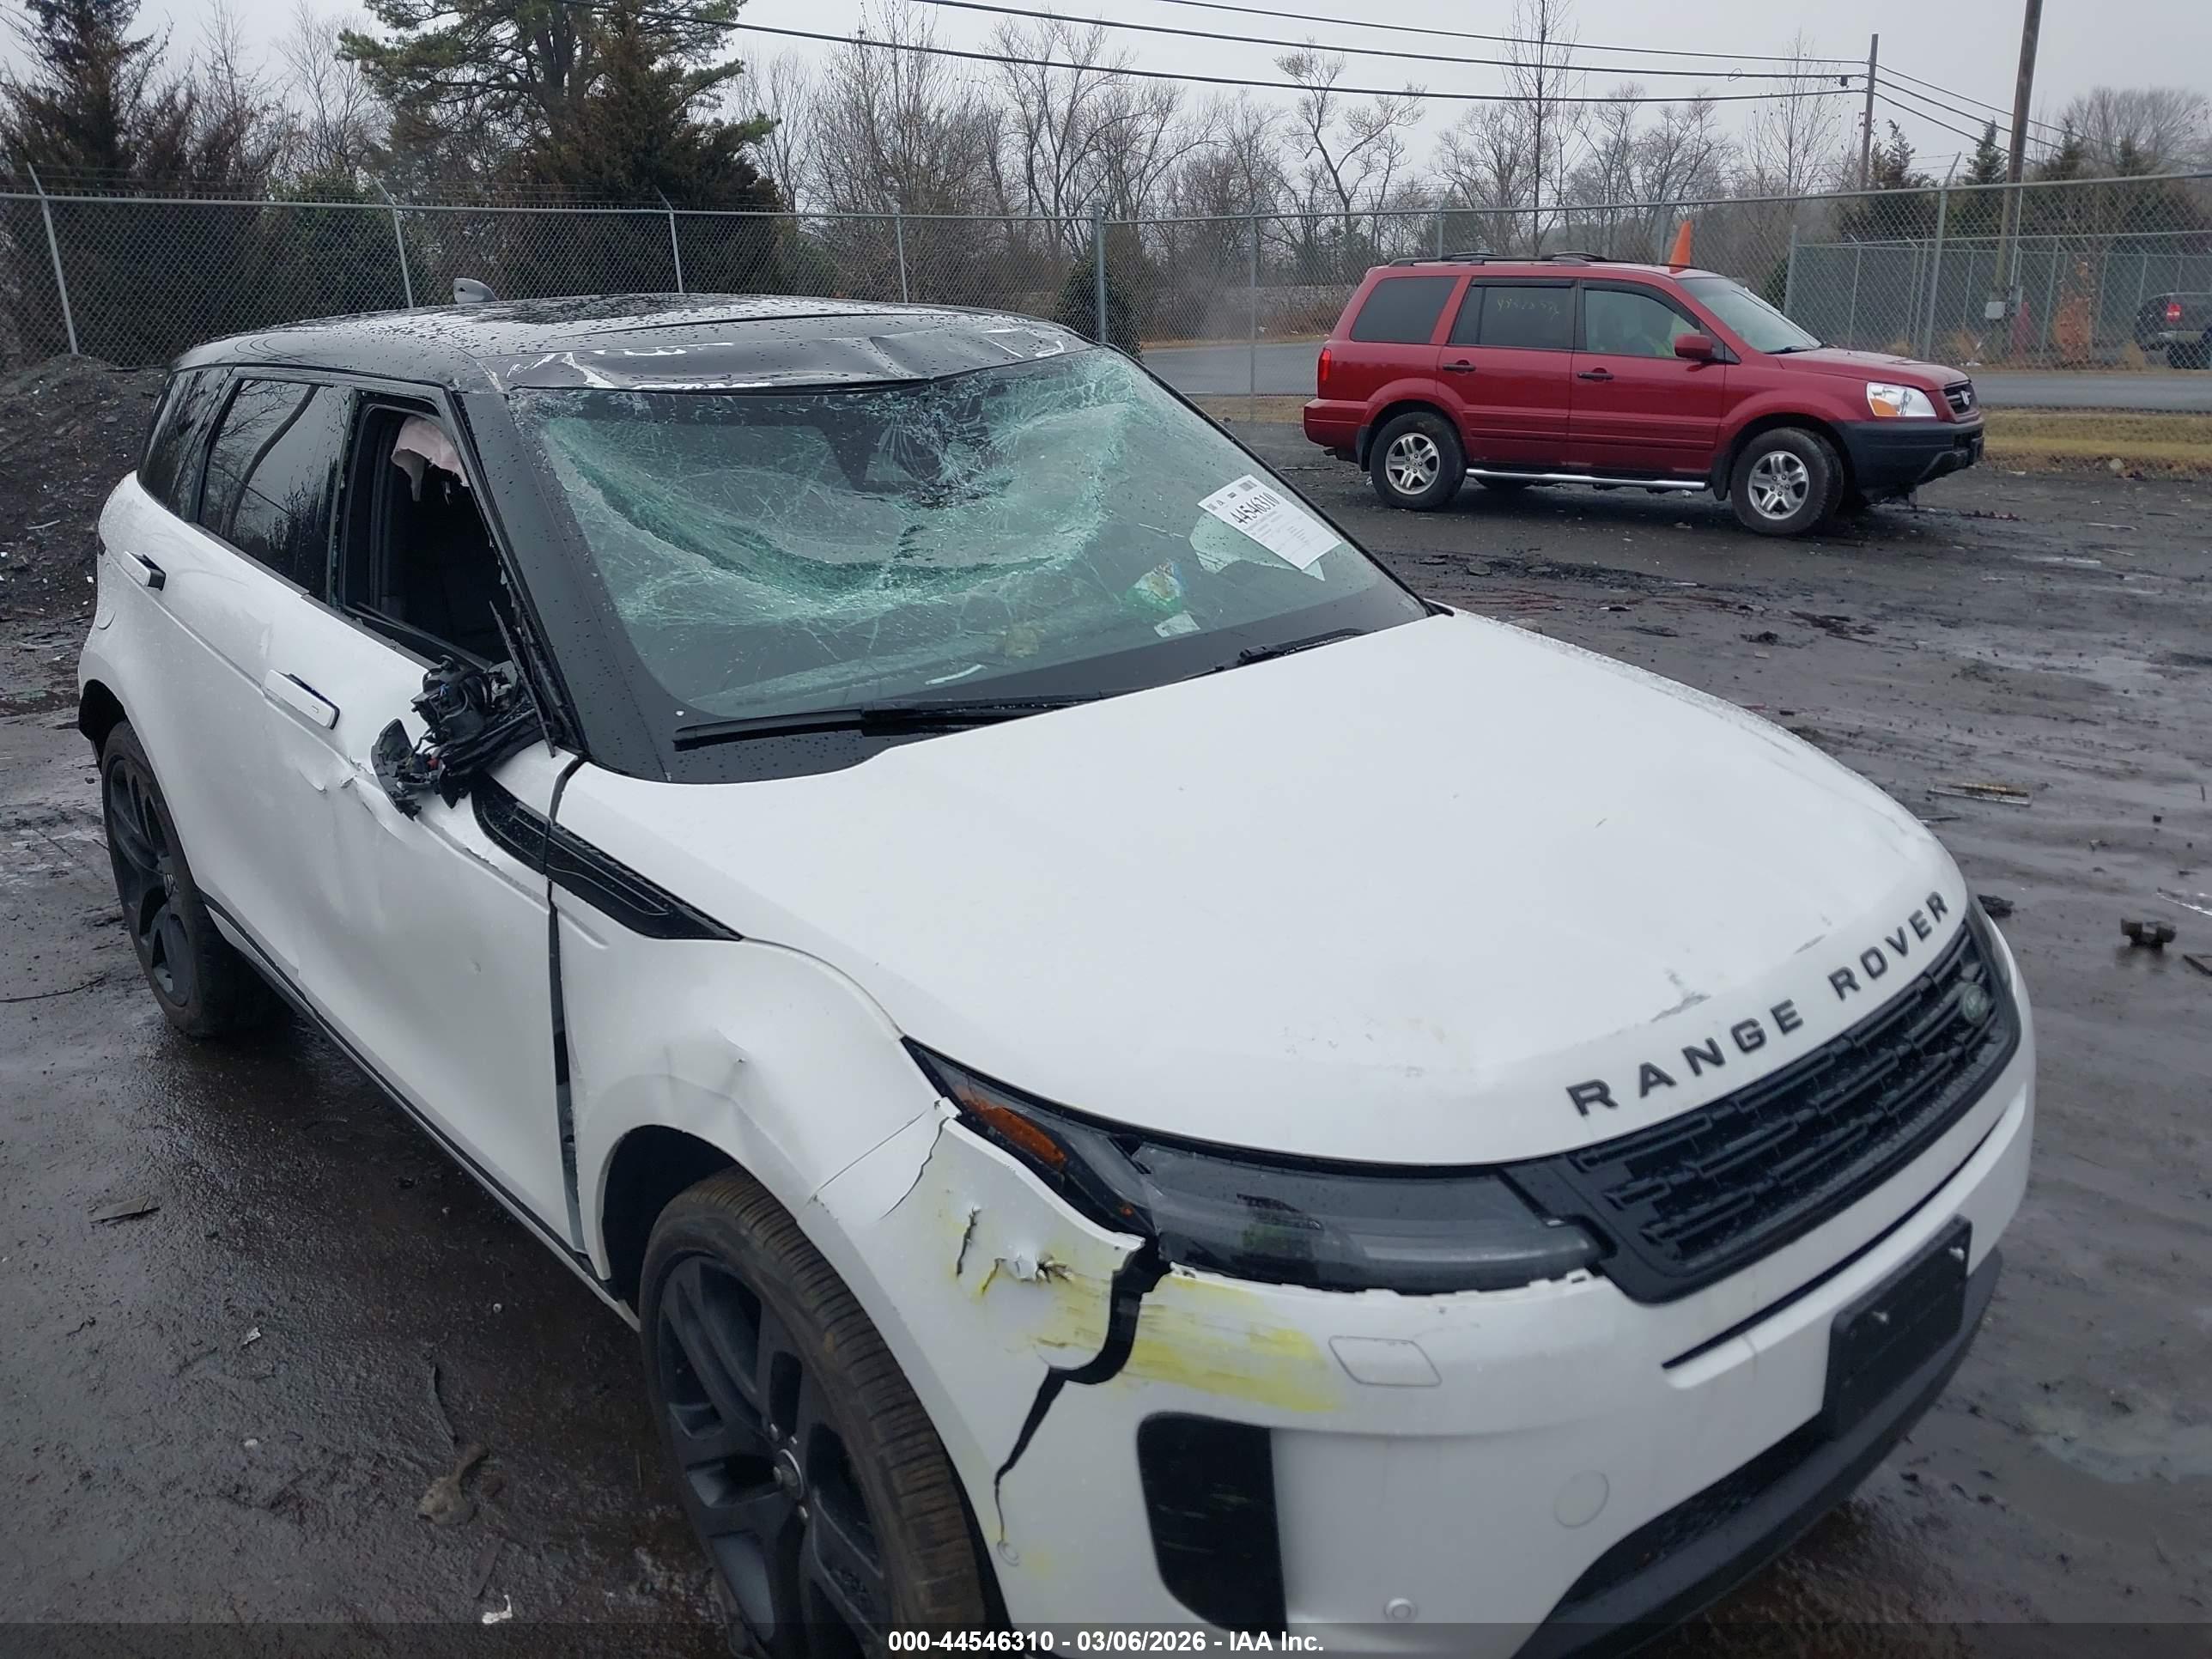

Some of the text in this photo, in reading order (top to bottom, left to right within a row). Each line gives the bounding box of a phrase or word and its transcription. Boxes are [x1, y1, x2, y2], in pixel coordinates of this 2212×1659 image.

[1230, 493, 1279, 524] 44546310
[1565, 891, 1948, 1116] RANGE ROVER
